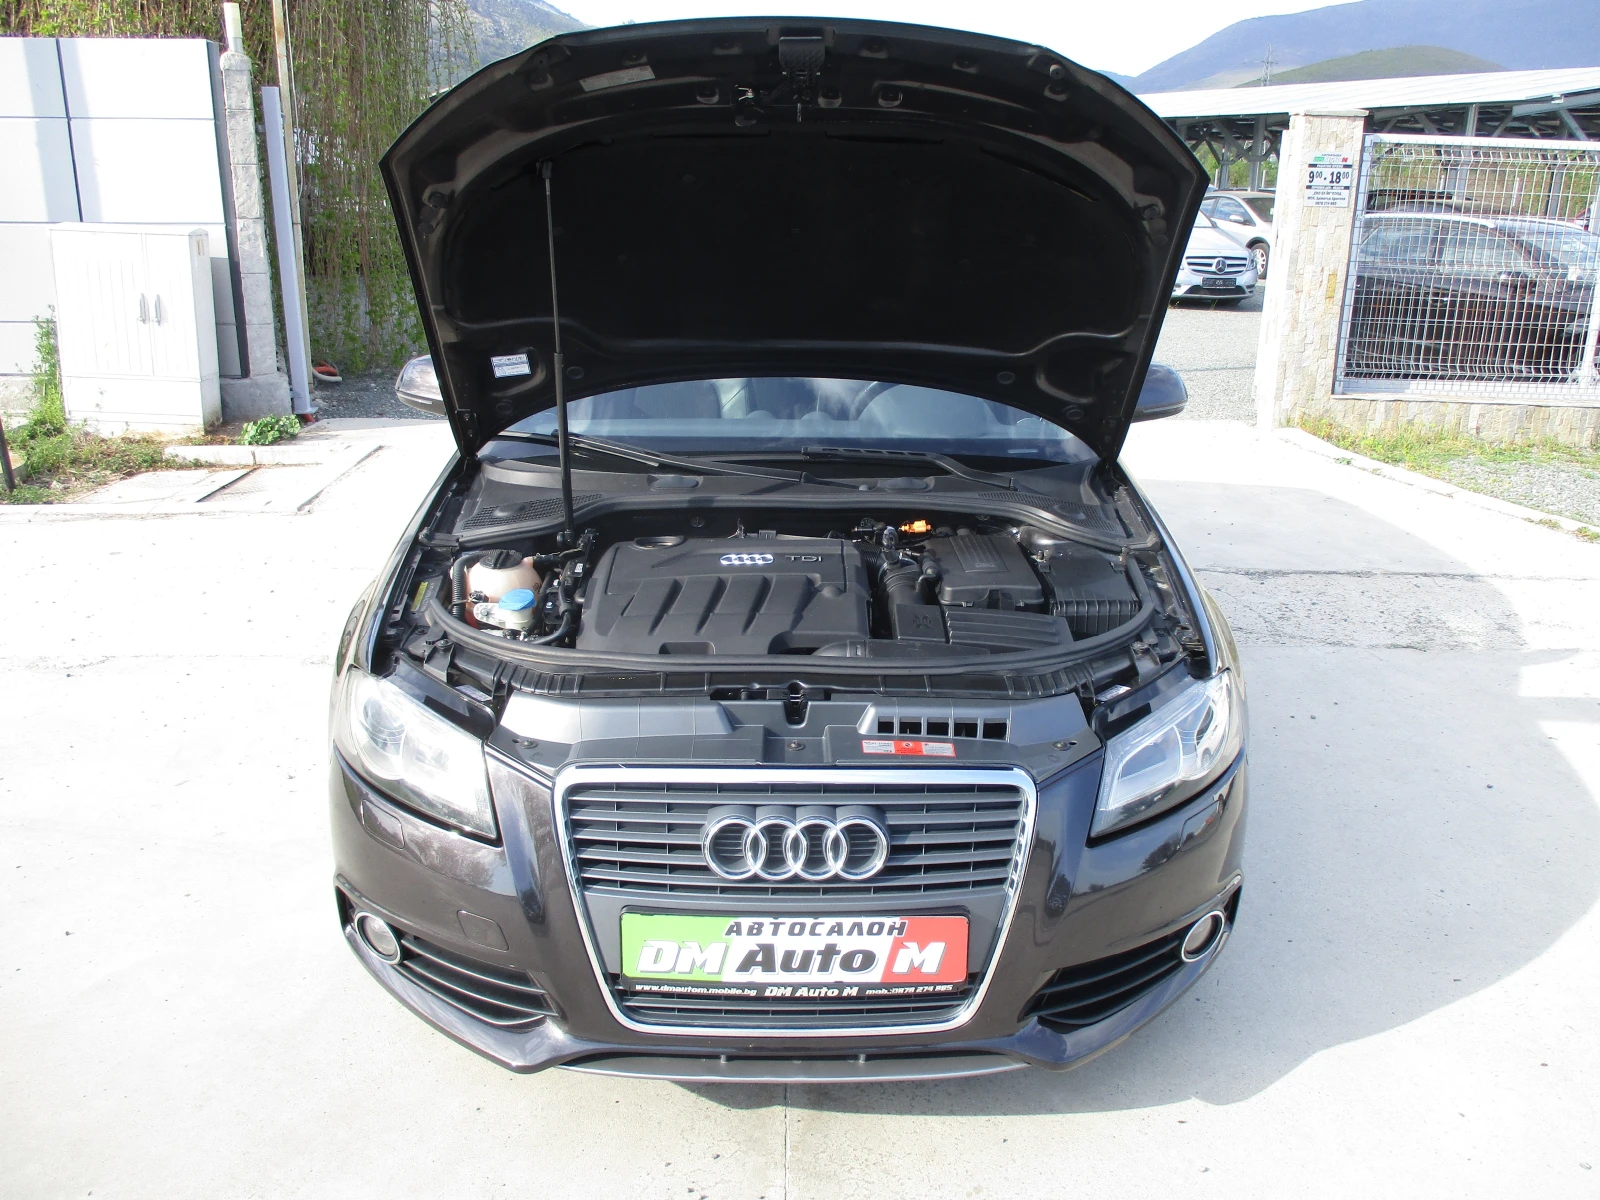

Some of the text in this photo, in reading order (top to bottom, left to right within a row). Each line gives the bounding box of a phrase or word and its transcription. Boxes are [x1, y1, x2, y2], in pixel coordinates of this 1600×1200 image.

[724, 921, 907, 937] АВТОСАЛОН
[636, 939, 947, 975] DM Auto M
[635, 983, 758, 997] www.dmautom.mobile.bg
[764, 985, 794, 997] DM
[795, 986, 840, 997] Auto
[842, 986, 859, 997] M
[916, 985, 934, 993] 274
